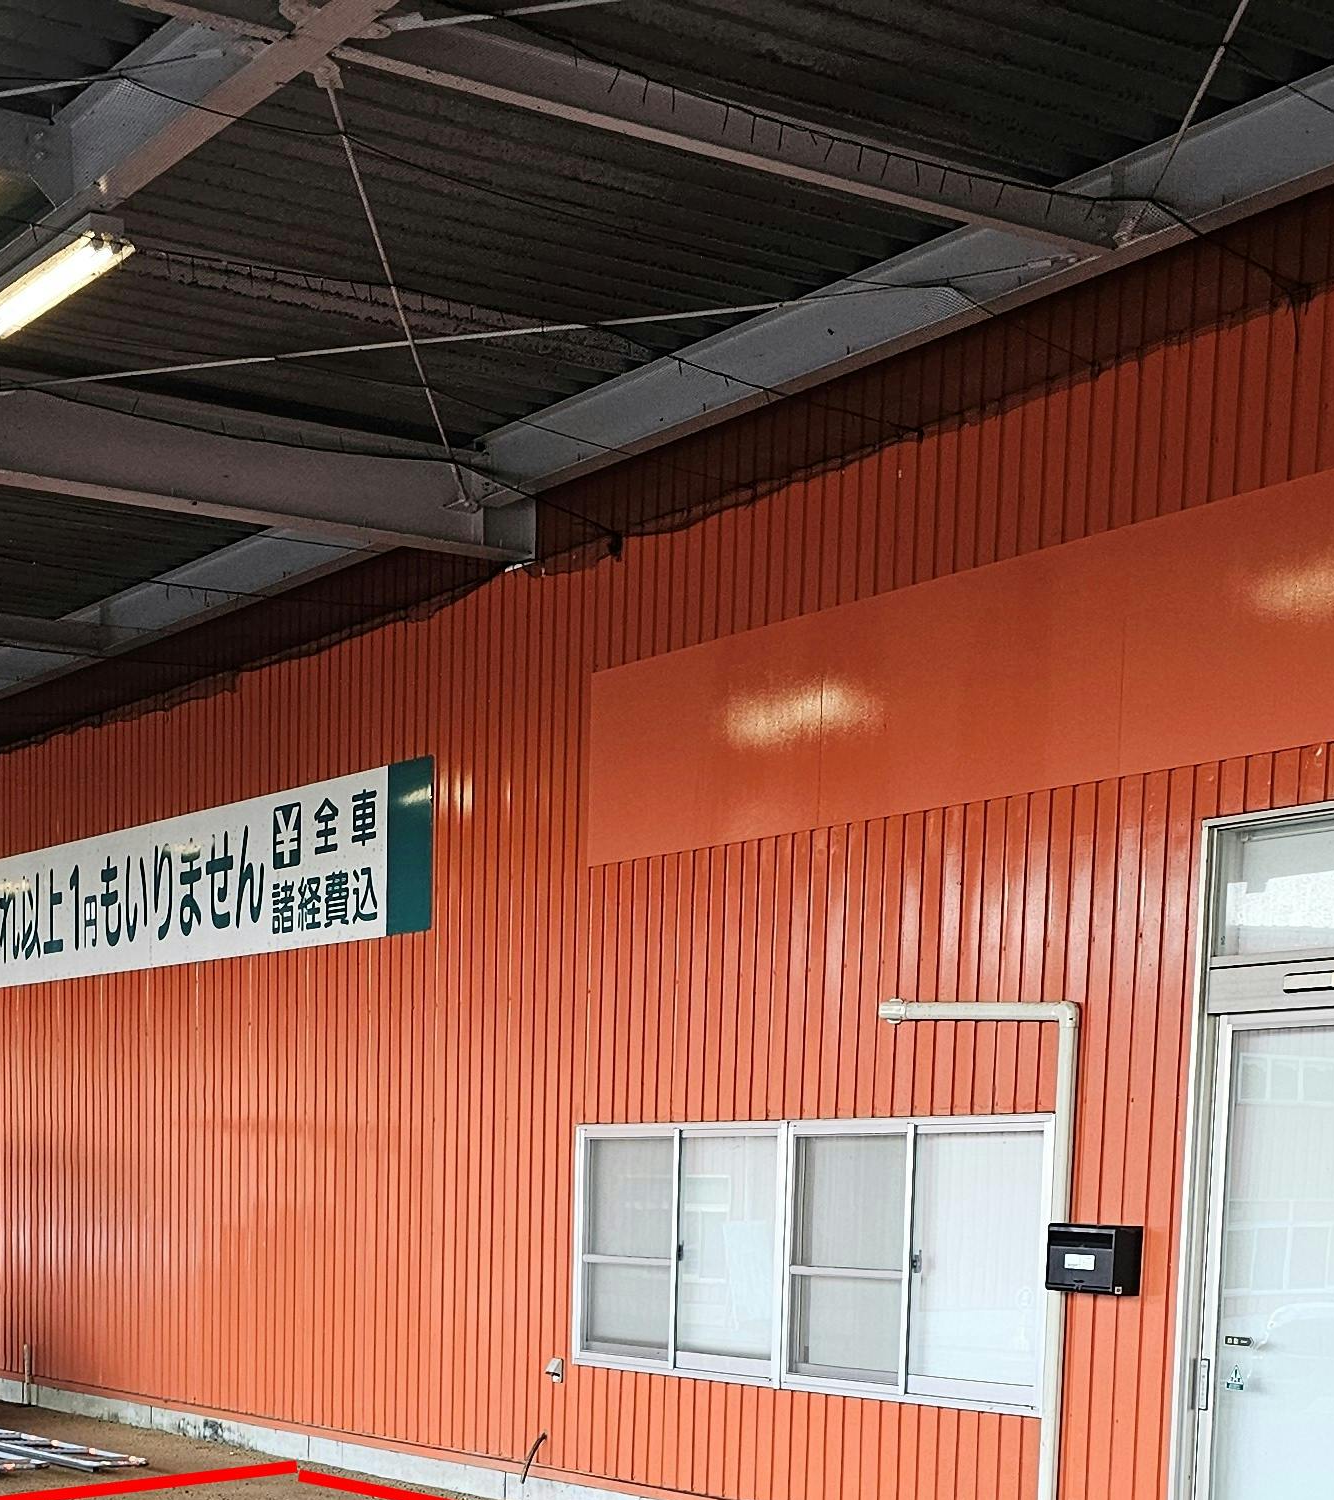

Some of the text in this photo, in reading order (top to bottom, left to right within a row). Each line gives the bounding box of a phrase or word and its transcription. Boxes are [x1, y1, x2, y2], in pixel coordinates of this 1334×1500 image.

[314, 788, 378, 855] 全車
[272, 866, 379, 935] 諸経費込
